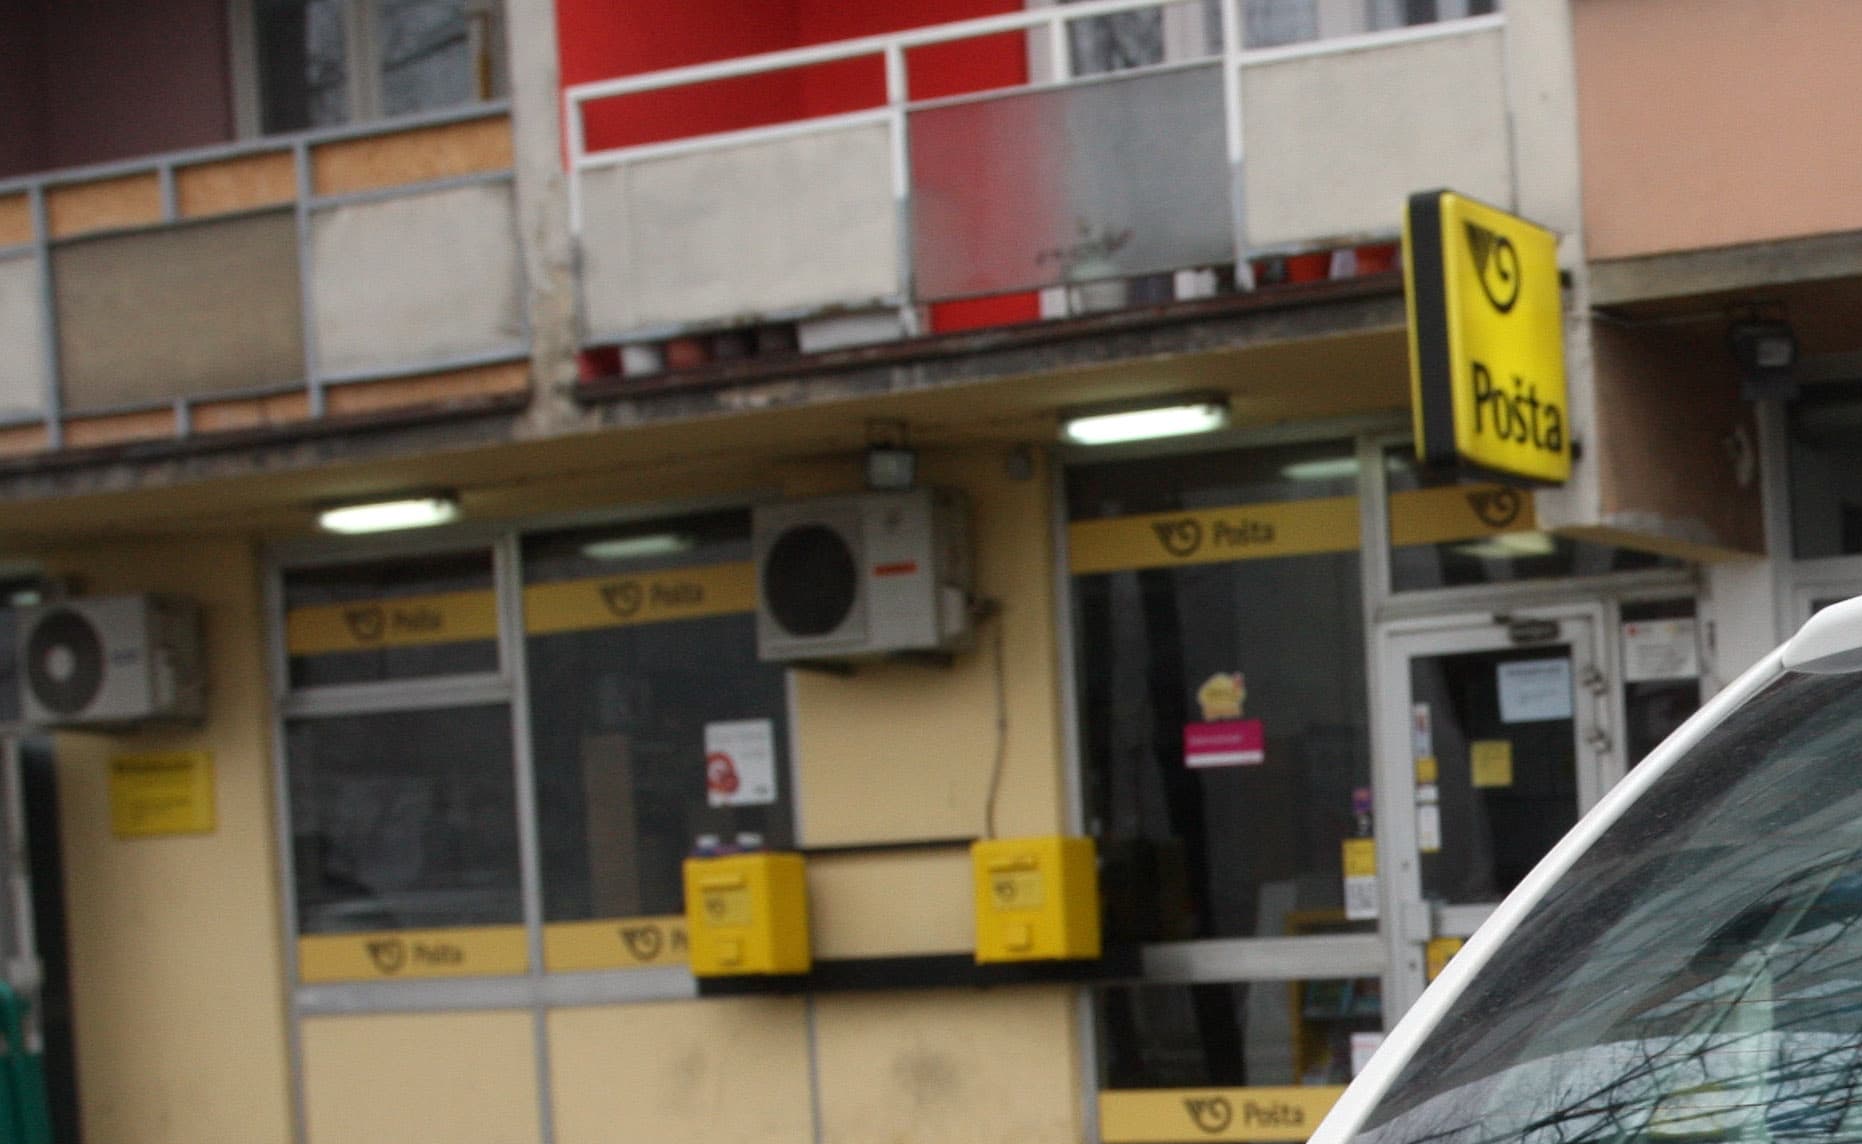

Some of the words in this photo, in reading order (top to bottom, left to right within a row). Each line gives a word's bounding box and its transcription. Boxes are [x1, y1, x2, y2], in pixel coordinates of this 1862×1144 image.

[1472, 362, 1563, 453] Pošta
[1213, 519, 1275, 546] Pošta
[1243, 1102, 1305, 1127] Pošta
